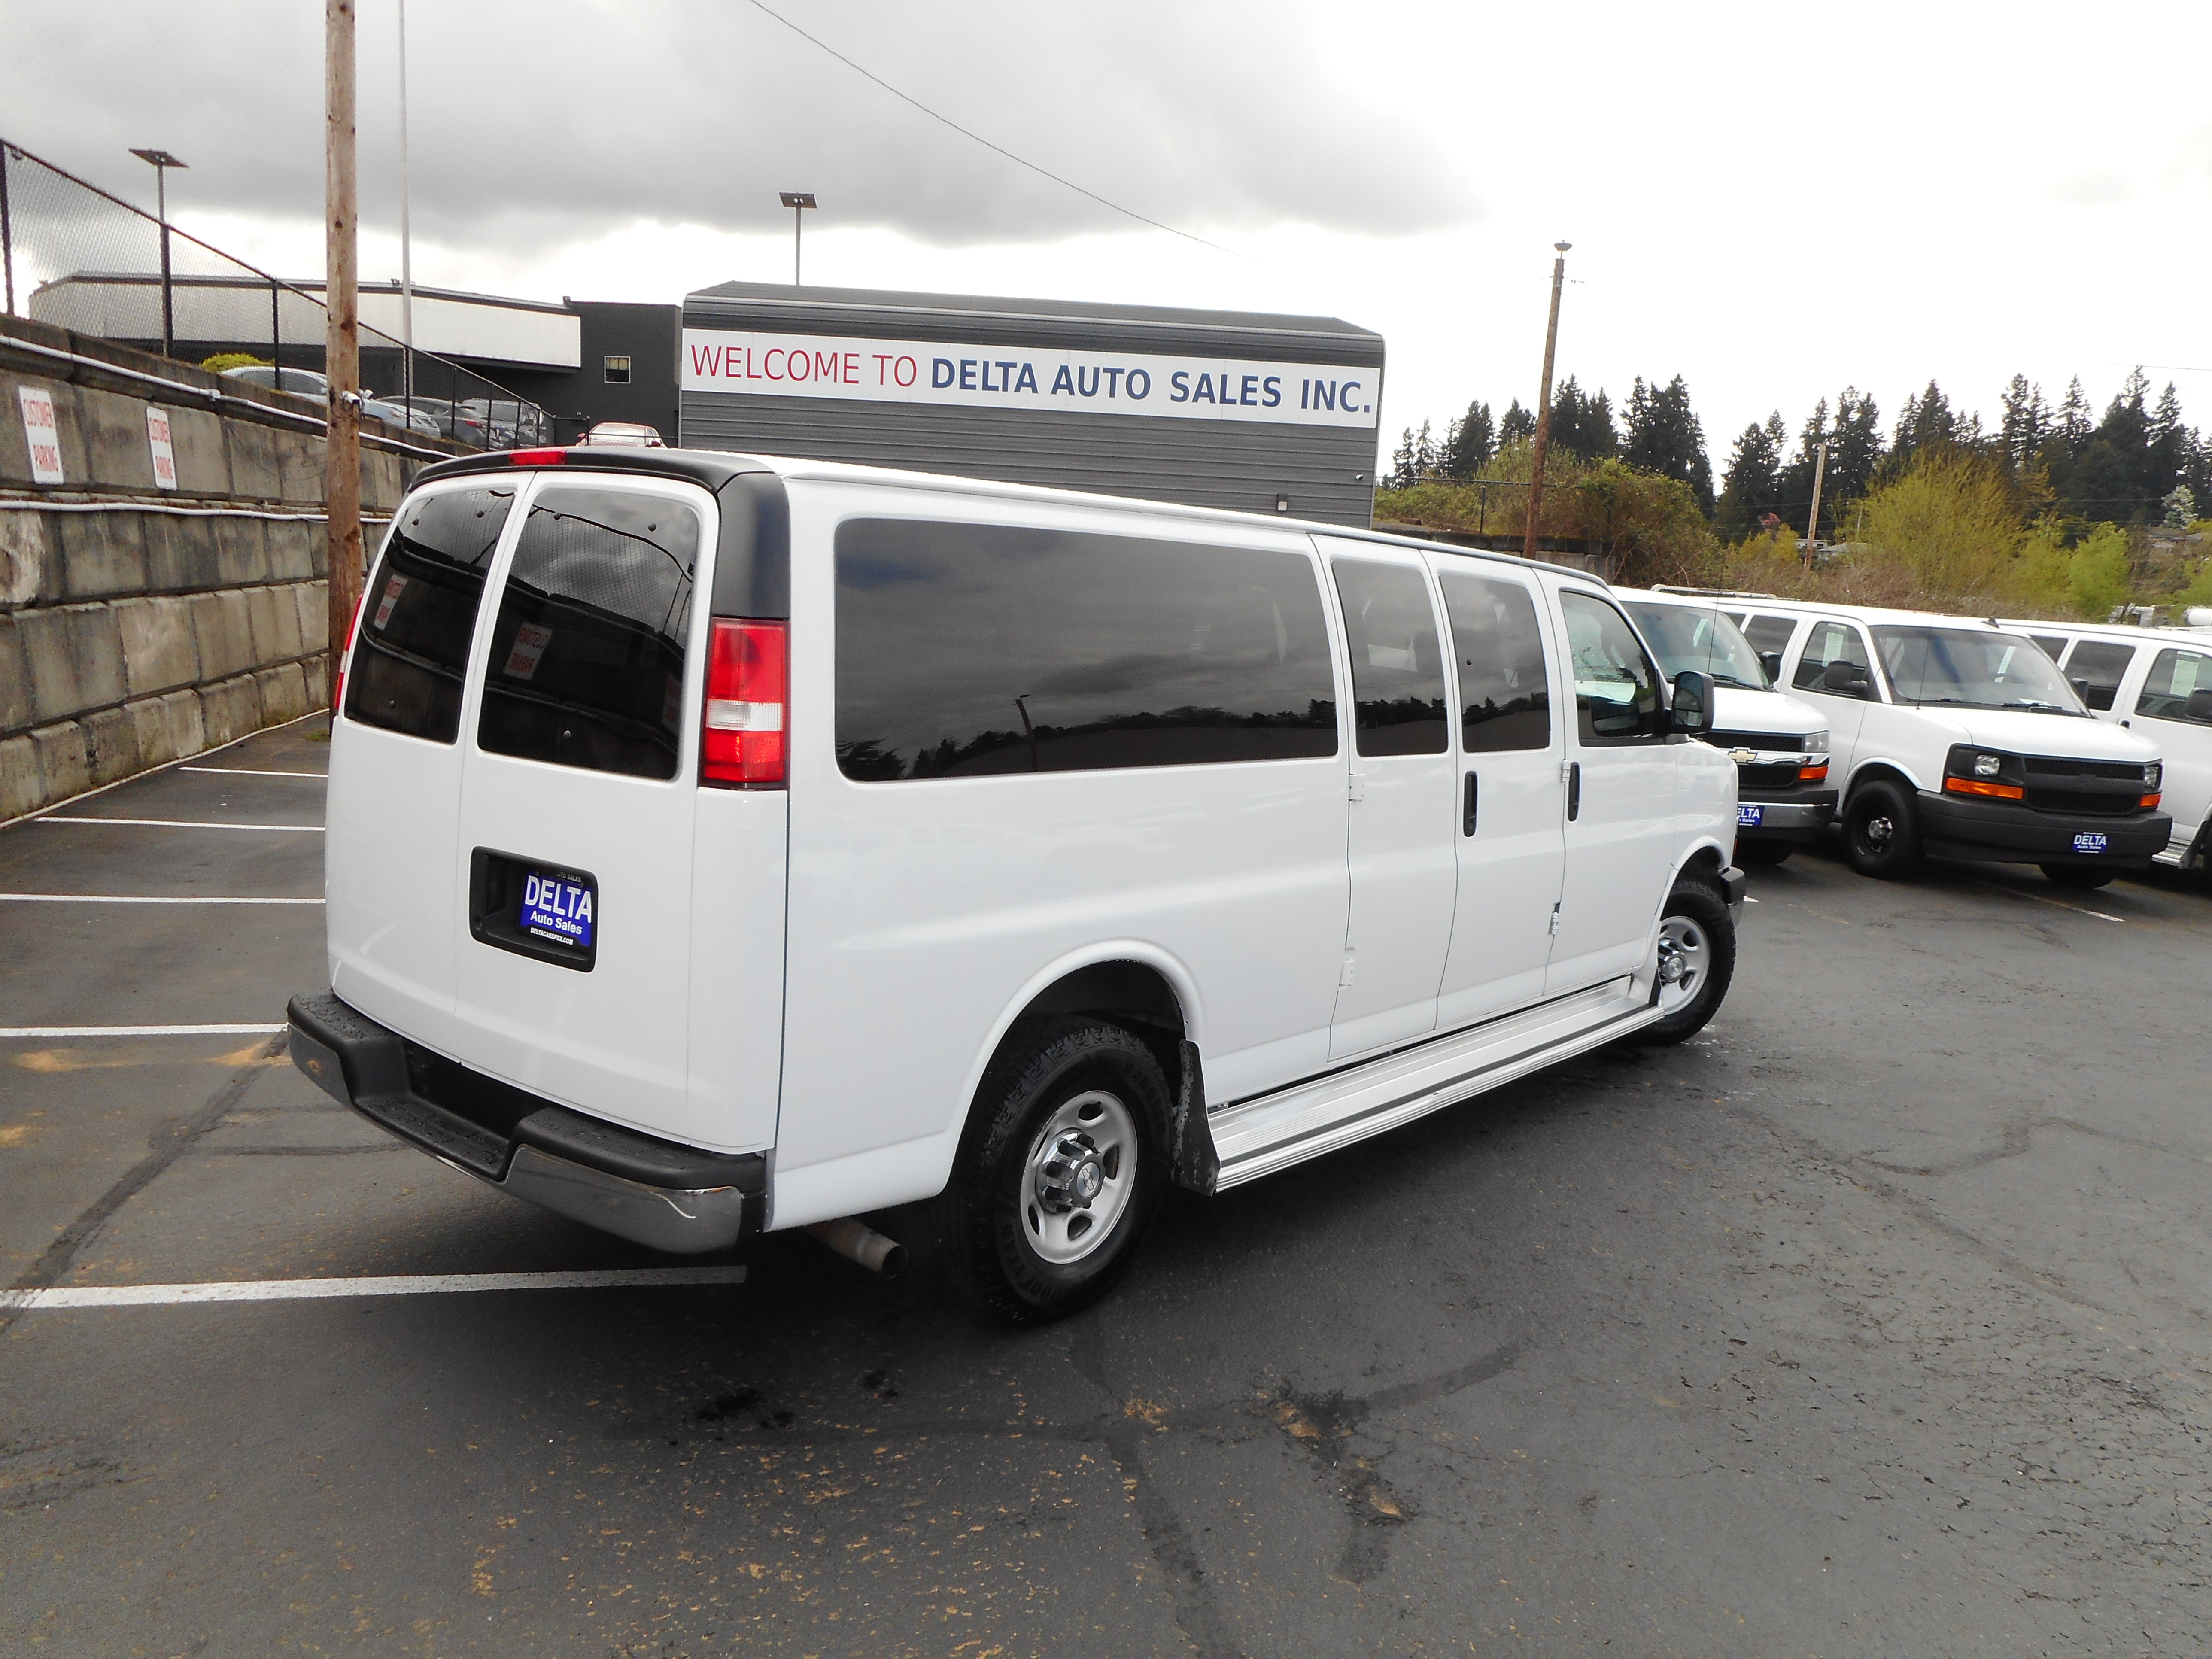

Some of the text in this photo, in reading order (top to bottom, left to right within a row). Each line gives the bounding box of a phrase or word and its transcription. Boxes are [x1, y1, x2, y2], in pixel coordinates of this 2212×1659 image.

[690, 344, 1370, 413] WELCOME TO DELTA AUTO SALES INC.
[23, 398, 57, 429] CUSTOMER
[1738, 808, 1760, 819] ELTA
[2073, 834, 2107, 846] DELTA
[524, 875, 592, 924] DELTA
[529, 910, 583, 935] Auto Sales
[1001, 1221, 1065, 1302] OODYEAR
